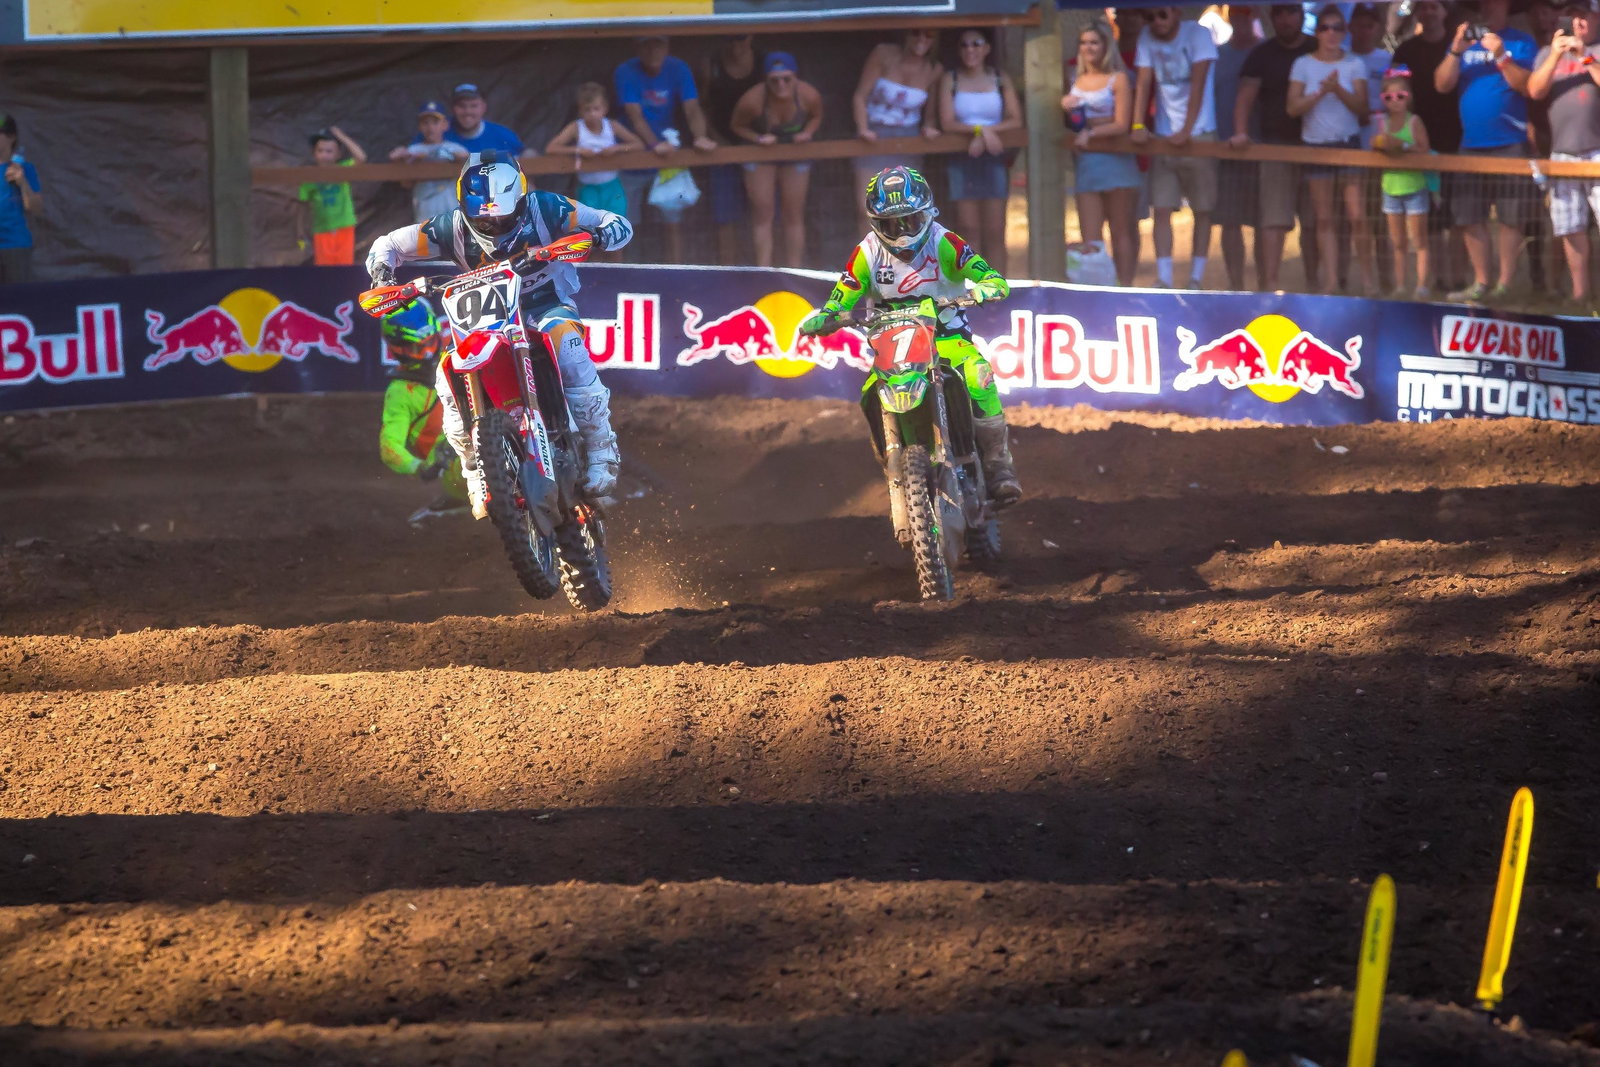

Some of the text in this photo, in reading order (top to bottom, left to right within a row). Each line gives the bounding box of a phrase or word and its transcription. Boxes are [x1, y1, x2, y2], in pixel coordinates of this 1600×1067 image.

[457, 284, 511, 331] 94
[584, 295, 660, 368] ull
[0, 304, 124, 384] Bull
[892, 328, 917, 364] 1
[1037, 316, 1158, 392] Bull
[1448, 320, 1560, 363] LUCAS OIL
[1398, 371, 1600, 425] MOTOCROSS
[536, 422, 551, 467] DUNLOP
